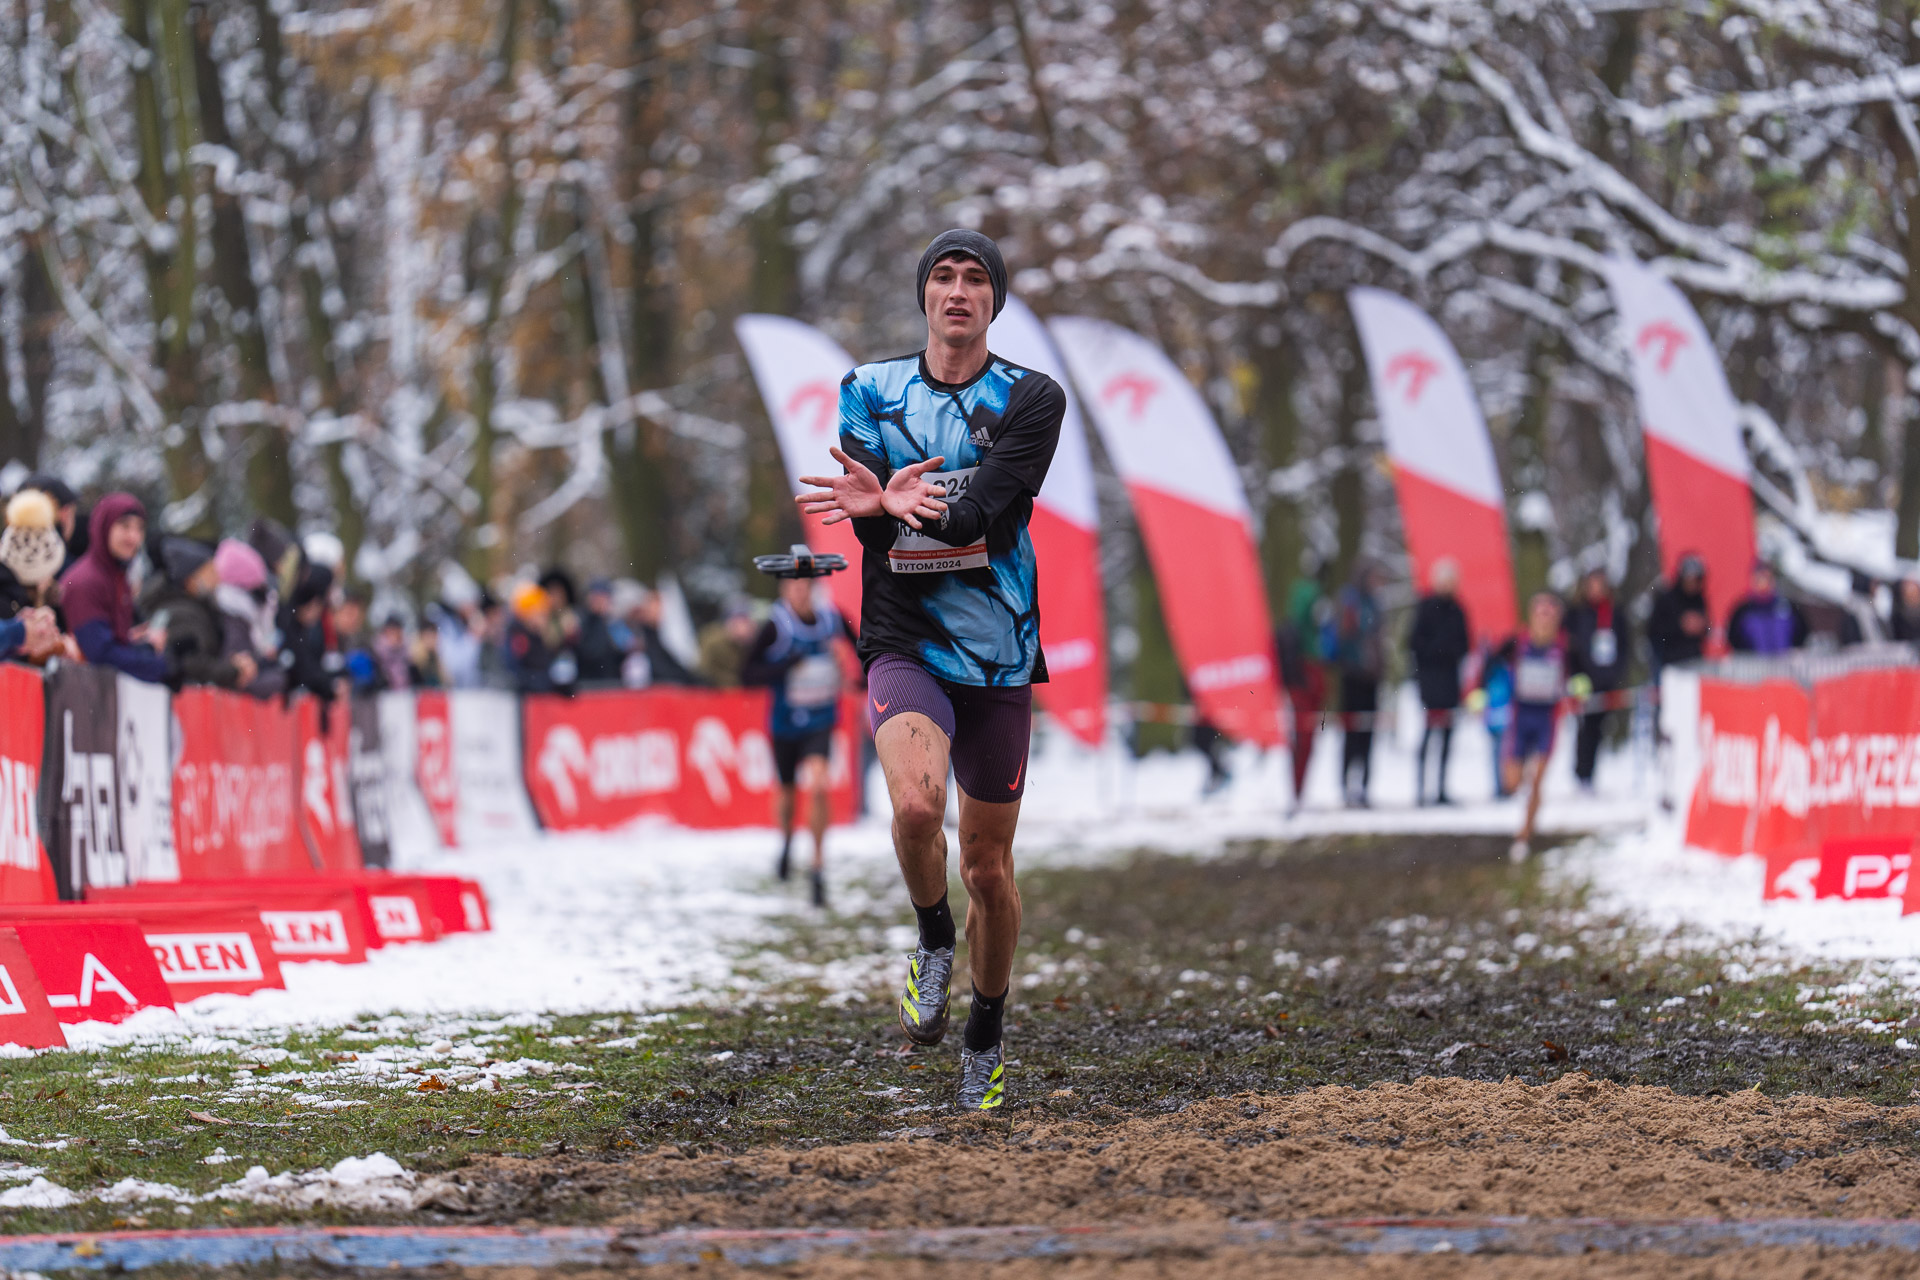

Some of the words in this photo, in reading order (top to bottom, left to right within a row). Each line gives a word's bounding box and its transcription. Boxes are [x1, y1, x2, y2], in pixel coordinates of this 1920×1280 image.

[966, 438, 993, 448] adidas
[897, 562, 934, 571] BYTOM
[936, 560, 961, 569] 2024
